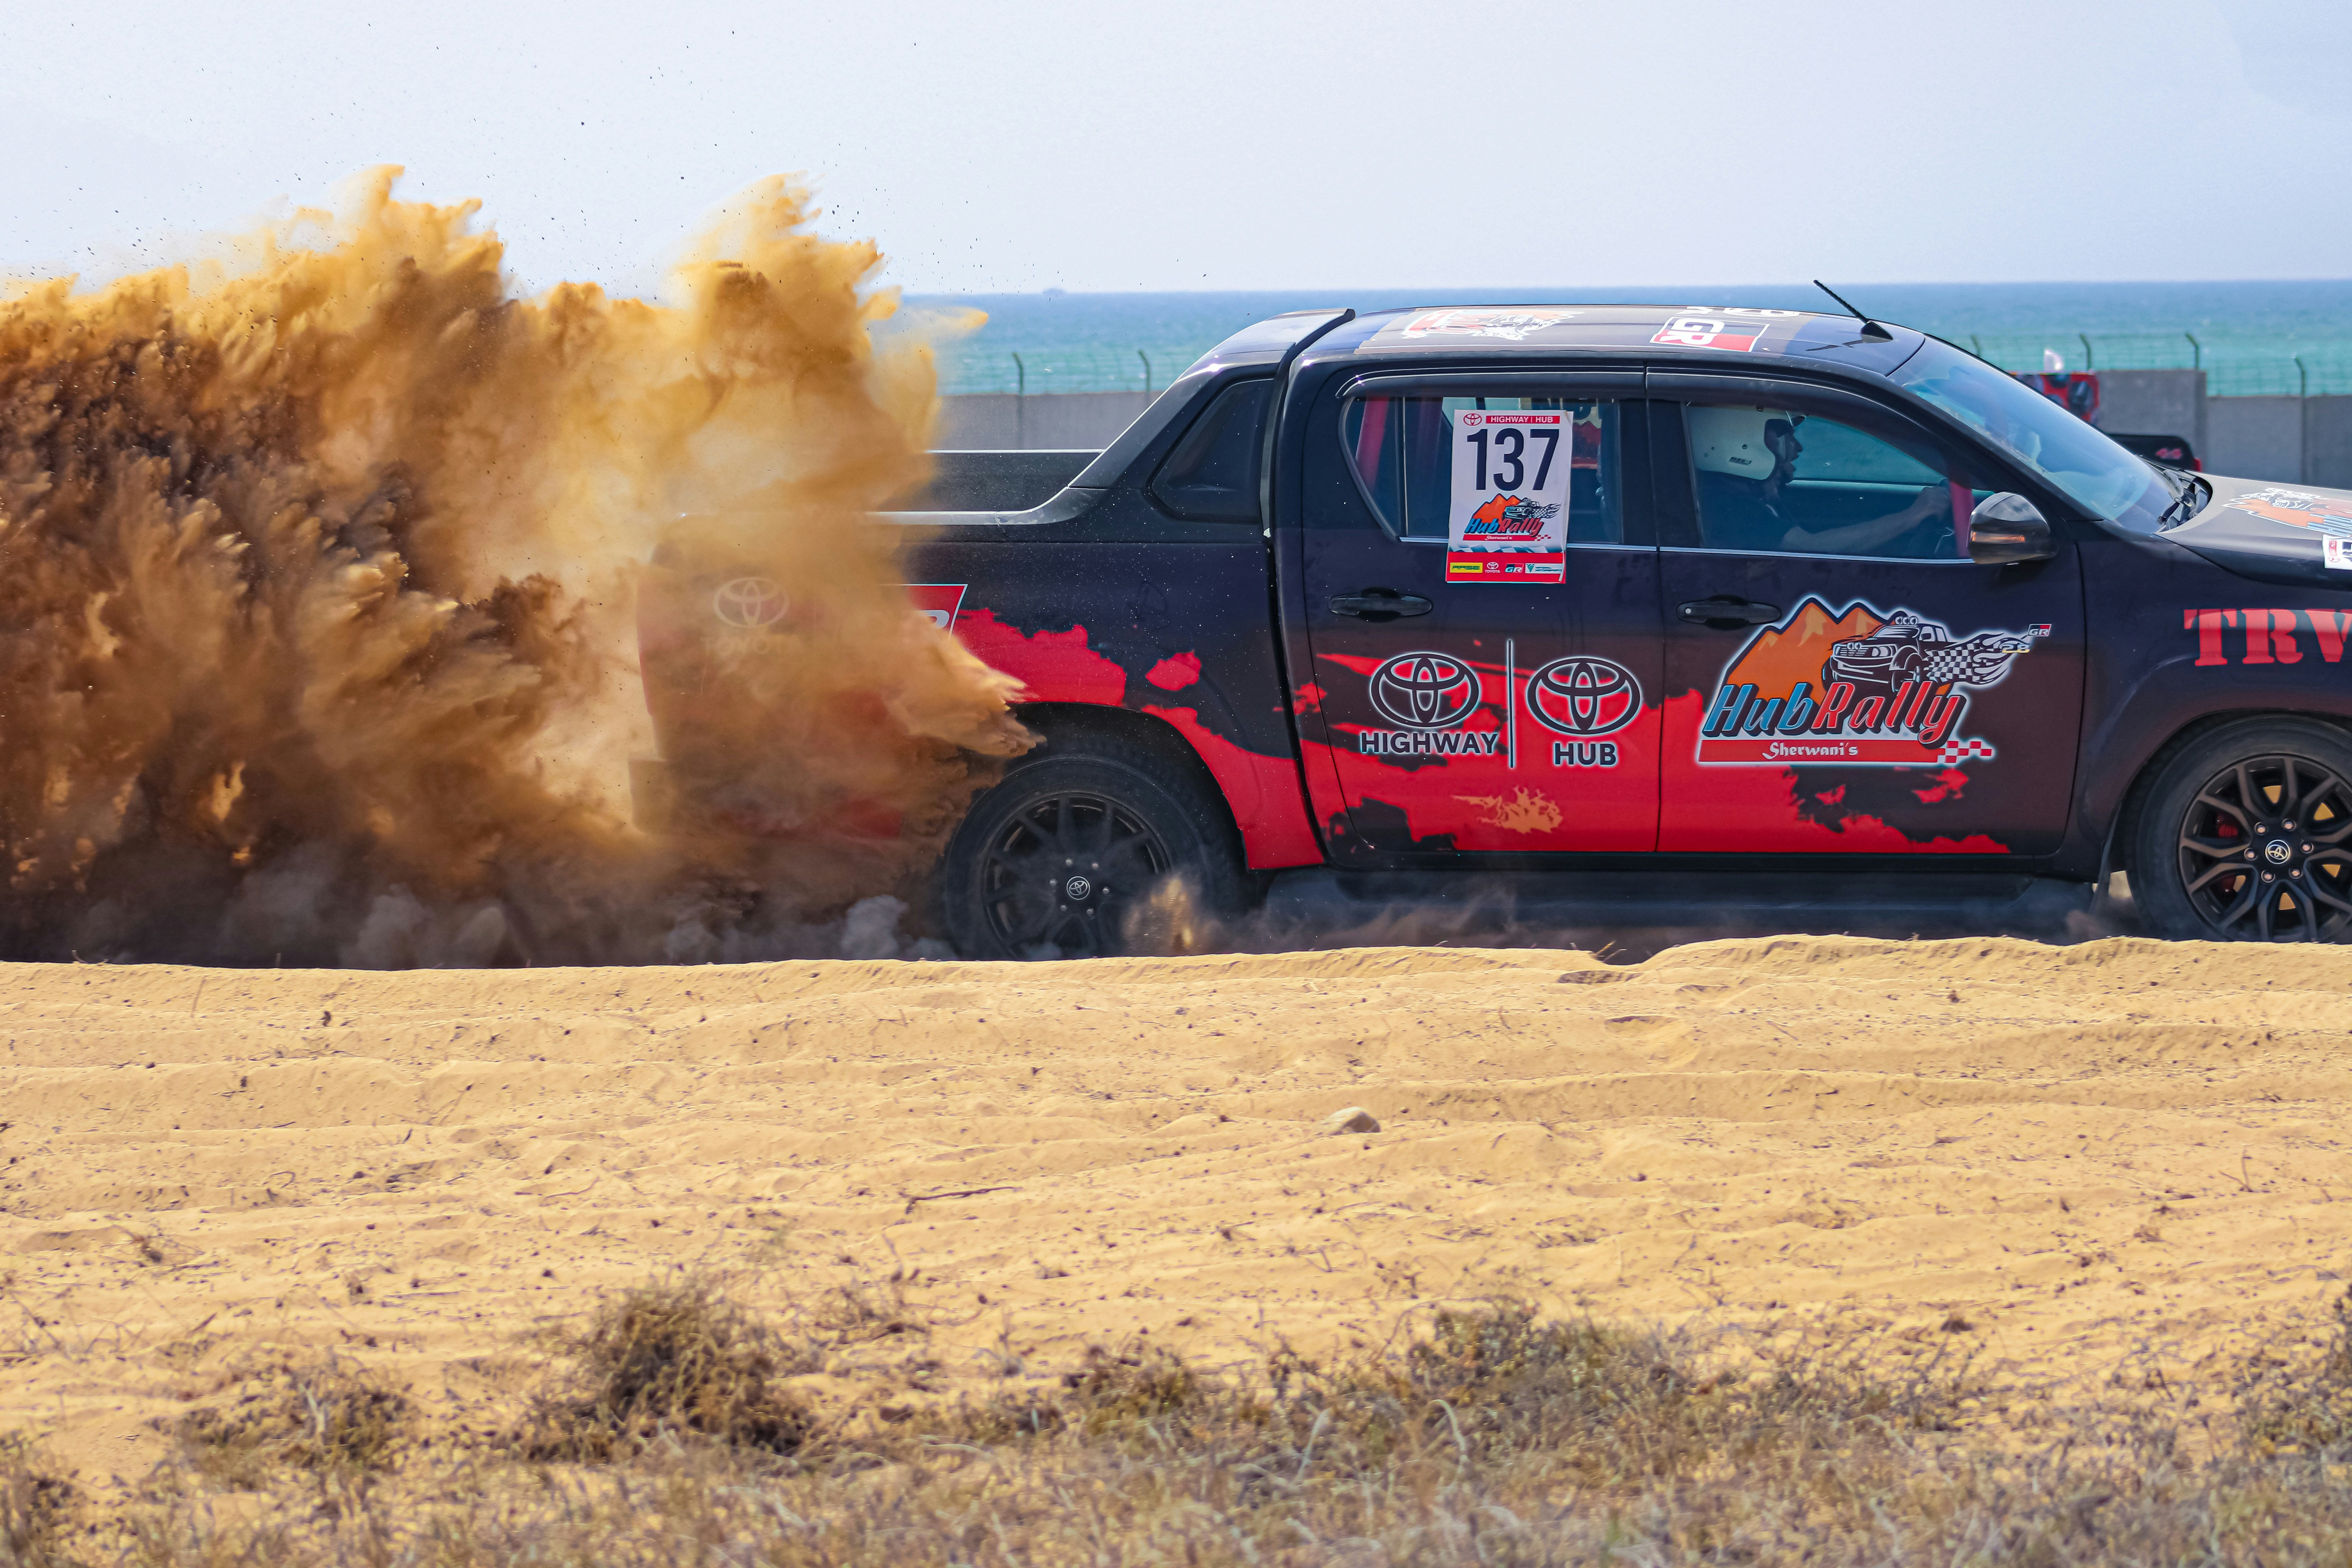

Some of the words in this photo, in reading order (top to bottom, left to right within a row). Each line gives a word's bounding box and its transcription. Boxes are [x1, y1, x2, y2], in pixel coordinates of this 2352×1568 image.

[1660, 318, 1725, 345] GR
[1466, 428, 1559, 491] 137
[1361, 732, 1498, 754] HIGHWAY
[1554, 742, 1617, 766] HUB
[1762, 742, 1858, 760] Sherwani's
